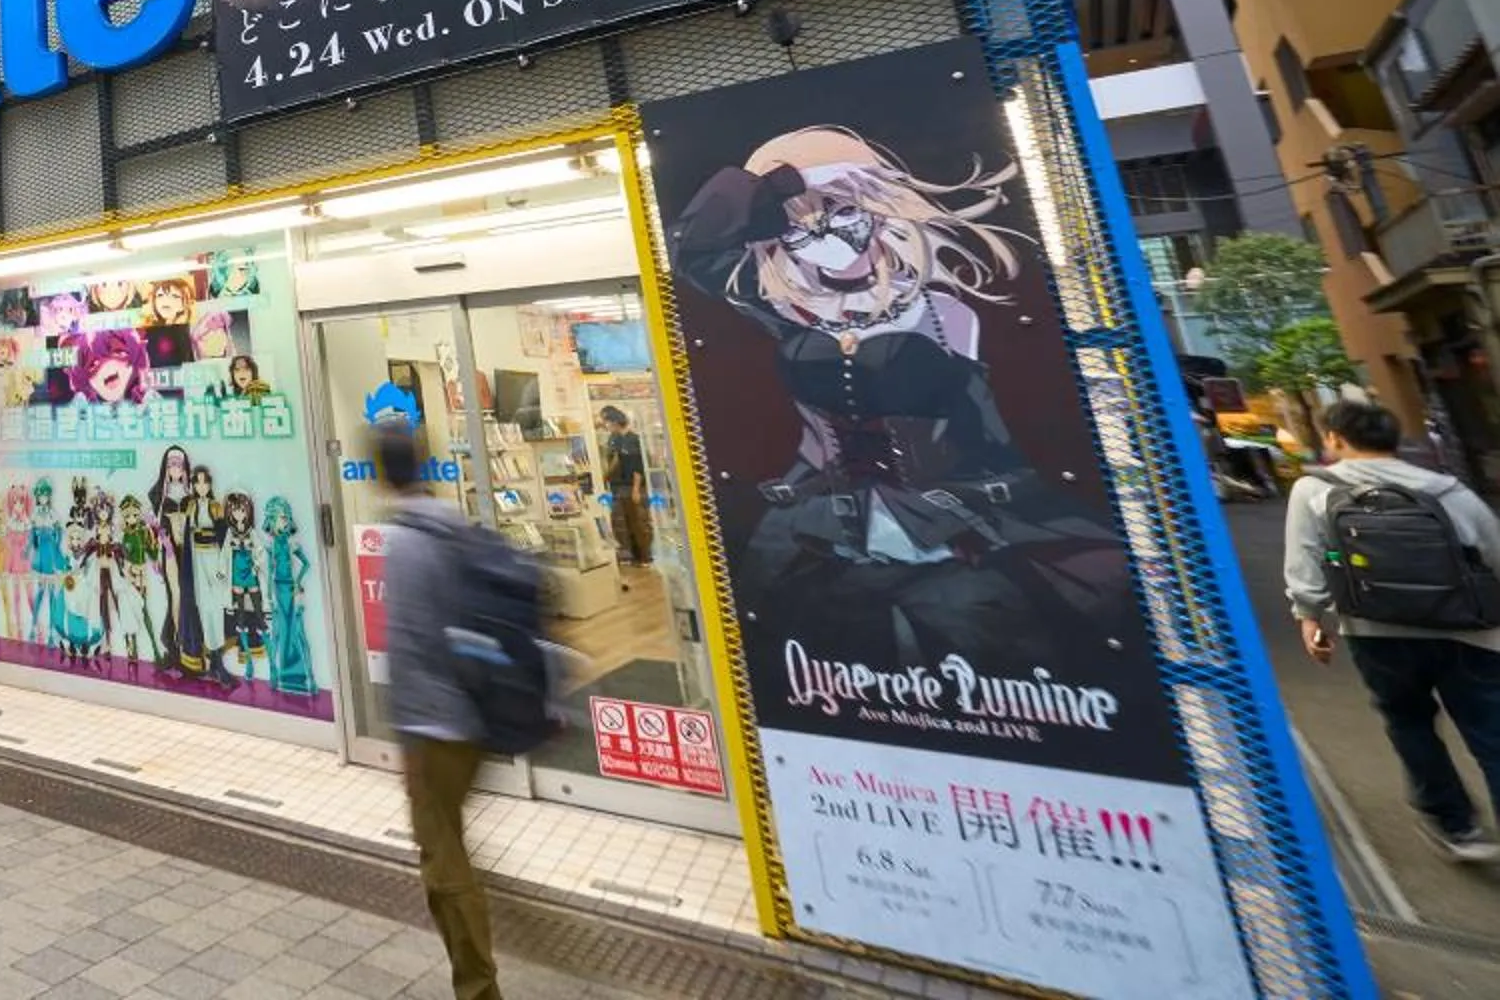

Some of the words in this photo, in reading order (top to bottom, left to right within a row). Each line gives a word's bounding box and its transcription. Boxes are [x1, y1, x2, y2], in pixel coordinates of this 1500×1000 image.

[244, 31, 346, 89] 4.24
[363, 10, 450, 56] Wed.
[342, 455, 460, 482] anate
[857, 705, 889, 723] Ave
[893, 709, 951, 732] Mujica
[955, 717, 989, 735] and
[992, 723, 1044, 742] LIVE
[809, 765, 846, 789] Ave
[853, 769, 939, 805] Mujica
[812, 794, 860, 822] 2nd
[869, 802, 945, 838] LIVE
[855, 845, 897, 871] 6.8
[1034, 878, 1076, 911] 7.7
